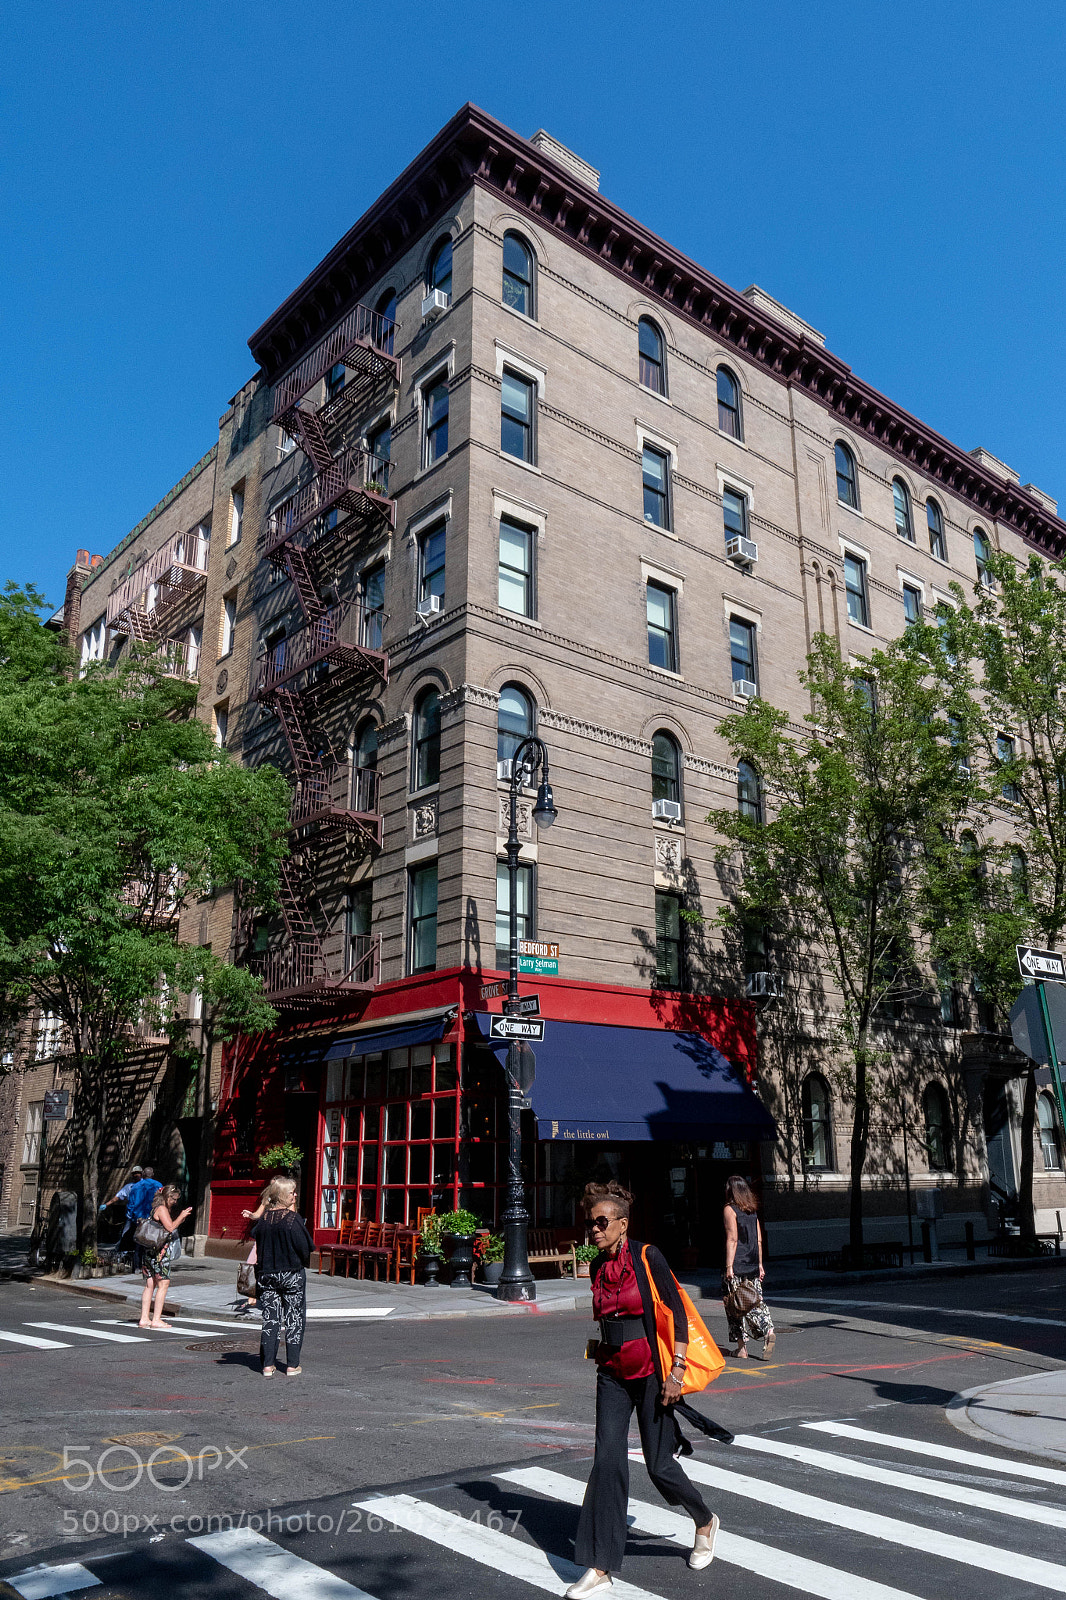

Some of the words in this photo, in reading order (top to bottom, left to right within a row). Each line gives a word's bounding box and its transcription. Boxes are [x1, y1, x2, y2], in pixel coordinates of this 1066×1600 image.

[519, 941, 548, 956] BEDFORD
[550, 945, 558, 957] ST
[520, 958, 534, 969] Larry
[535, 959, 557, 969] Selman
[1026, 956, 1041, 970] ONE
[1045, 959, 1060, 973] WAY
[480, 984, 500, 999] GROVE
[502, 982, 509, 995] ST
[522, 1000, 535, 1011] WAY
[499, 1022, 515, 1032] ONE
[521, 1024, 538, 1034] WAY
[563, 1129, 575, 1139] the
[577, 1129, 595, 1139] little
[596, 1130, 610, 1139] owl
